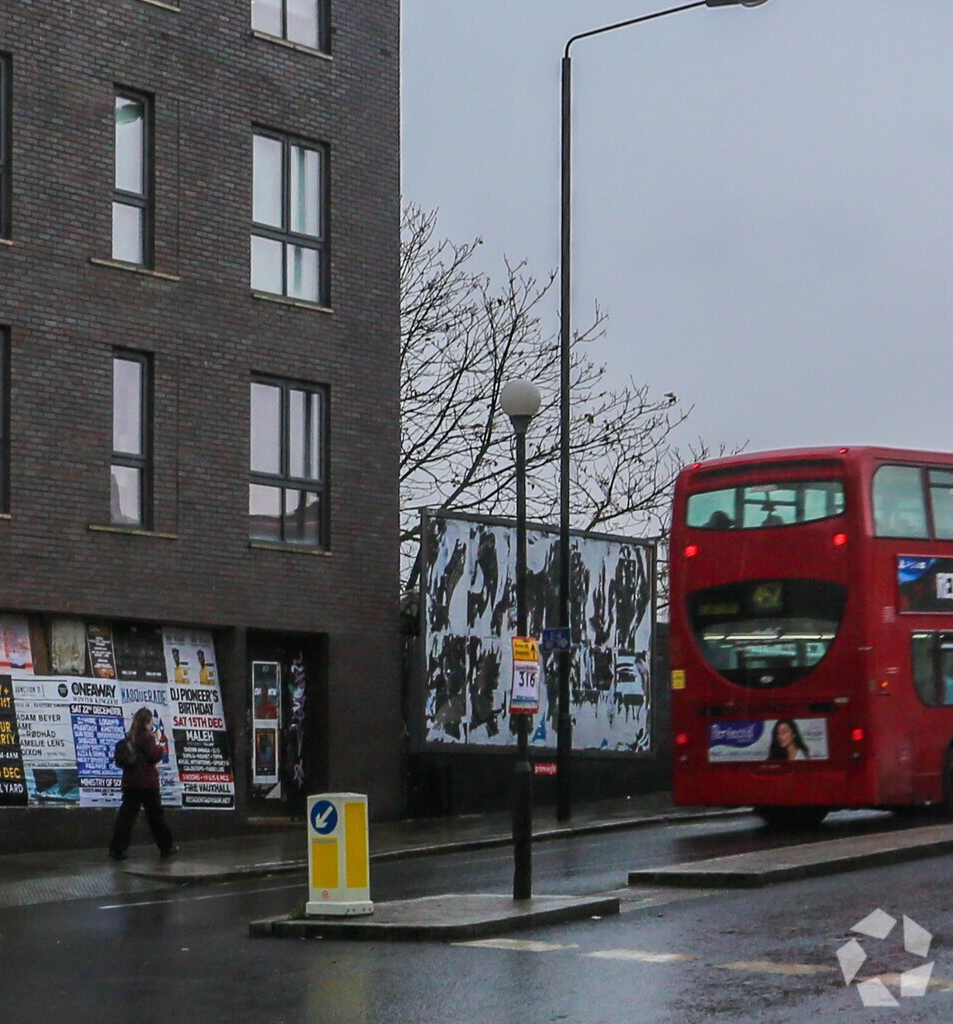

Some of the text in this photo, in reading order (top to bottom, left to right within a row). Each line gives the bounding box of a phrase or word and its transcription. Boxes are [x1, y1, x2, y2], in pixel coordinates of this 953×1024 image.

[518, 671, 536, 688] 316
[71, 681, 116, 698] ONEAWAY
[169, 687, 219, 702] DJ PIONEER'S
[71, 705, 82, 713] SAT
[178, 702, 214, 716] BIRTHDAY
[16, 714, 61, 722] ADAM BEYER
[173, 716, 223, 728] SAT 15TH DEC
[20, 739, 65, 748] AMELIE LENS
[3, 767, 21, 779] DEC
[106, 778, 114, 787] OF
[198, 783, 231, 793] VAUXHALL
